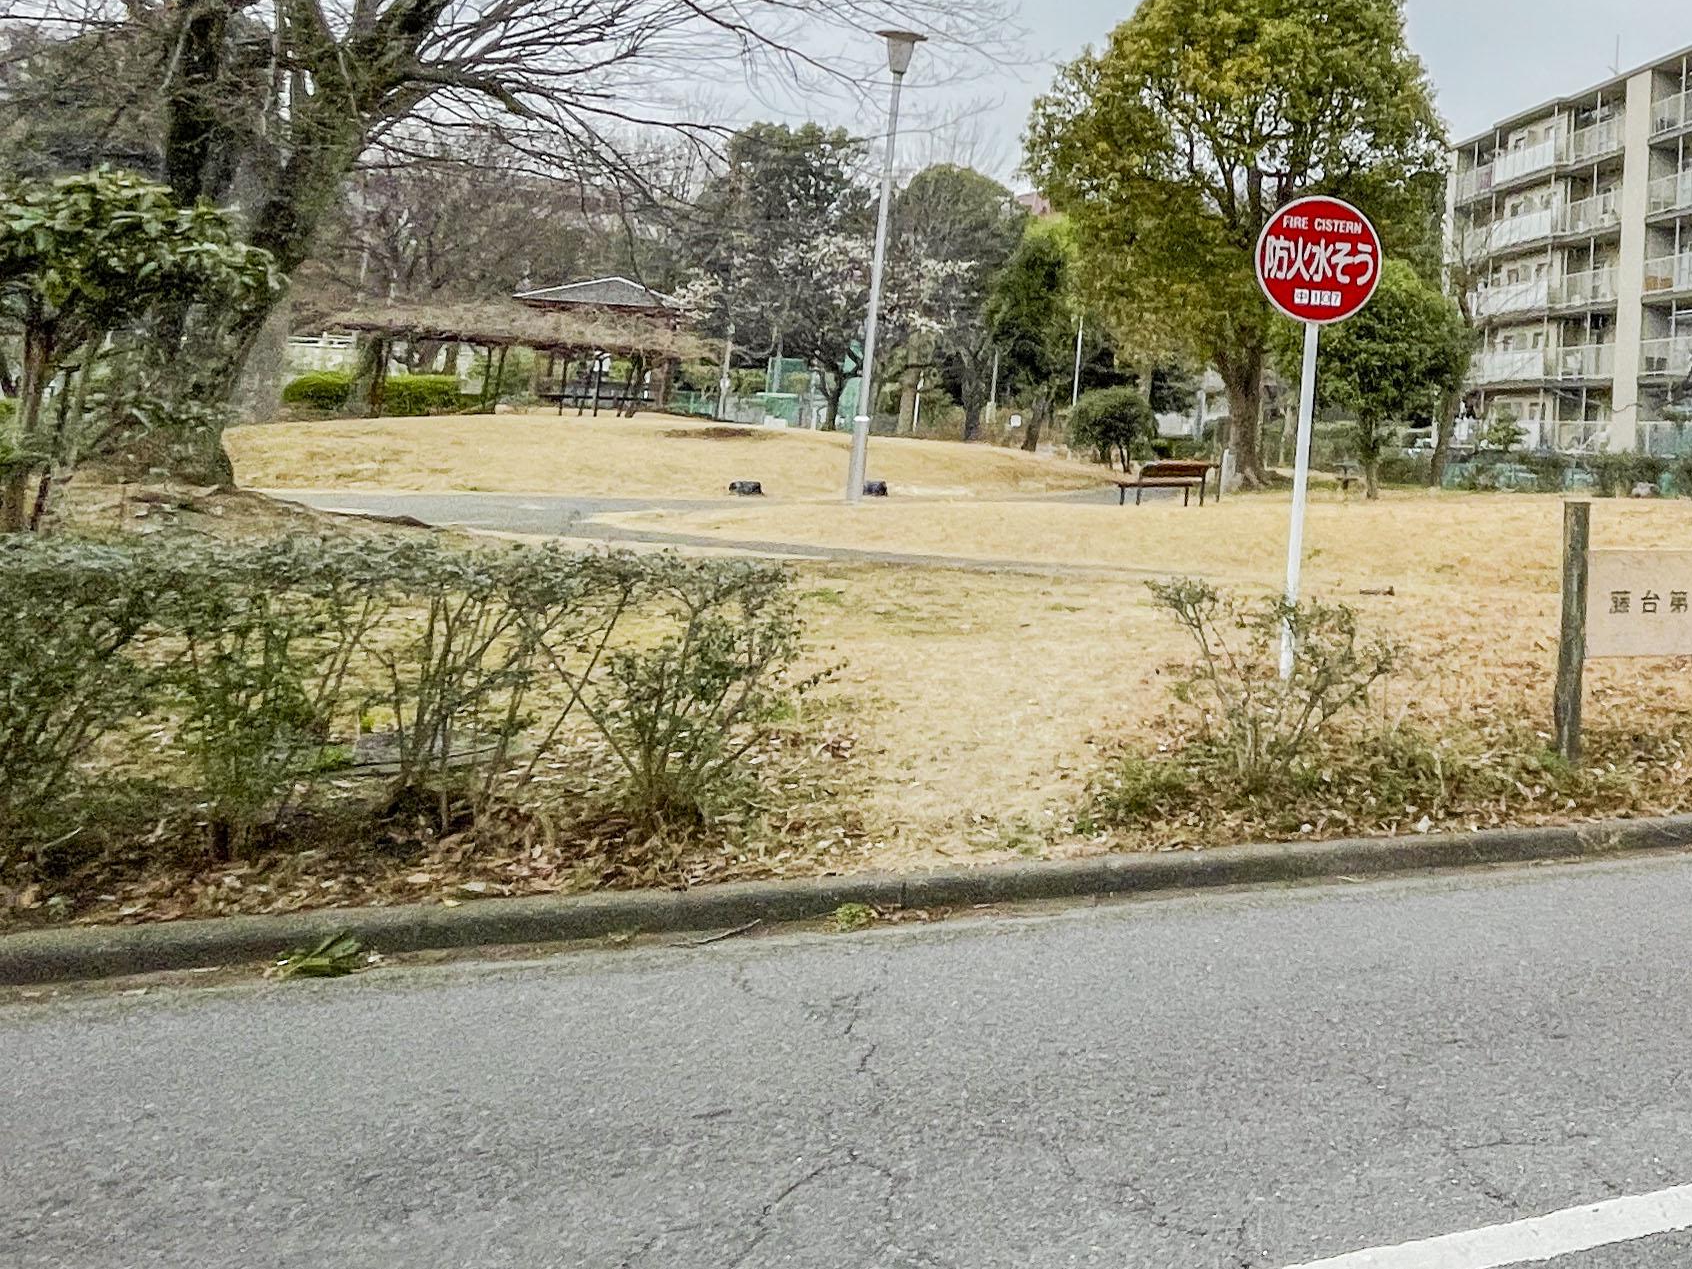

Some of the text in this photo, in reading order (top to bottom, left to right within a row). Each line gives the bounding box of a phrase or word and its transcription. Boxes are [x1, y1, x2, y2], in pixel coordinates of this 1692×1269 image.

[1283, 216, 1362, 234] FIRE CISTERN
[1264, 234, 1374, 286] 防火水そう
